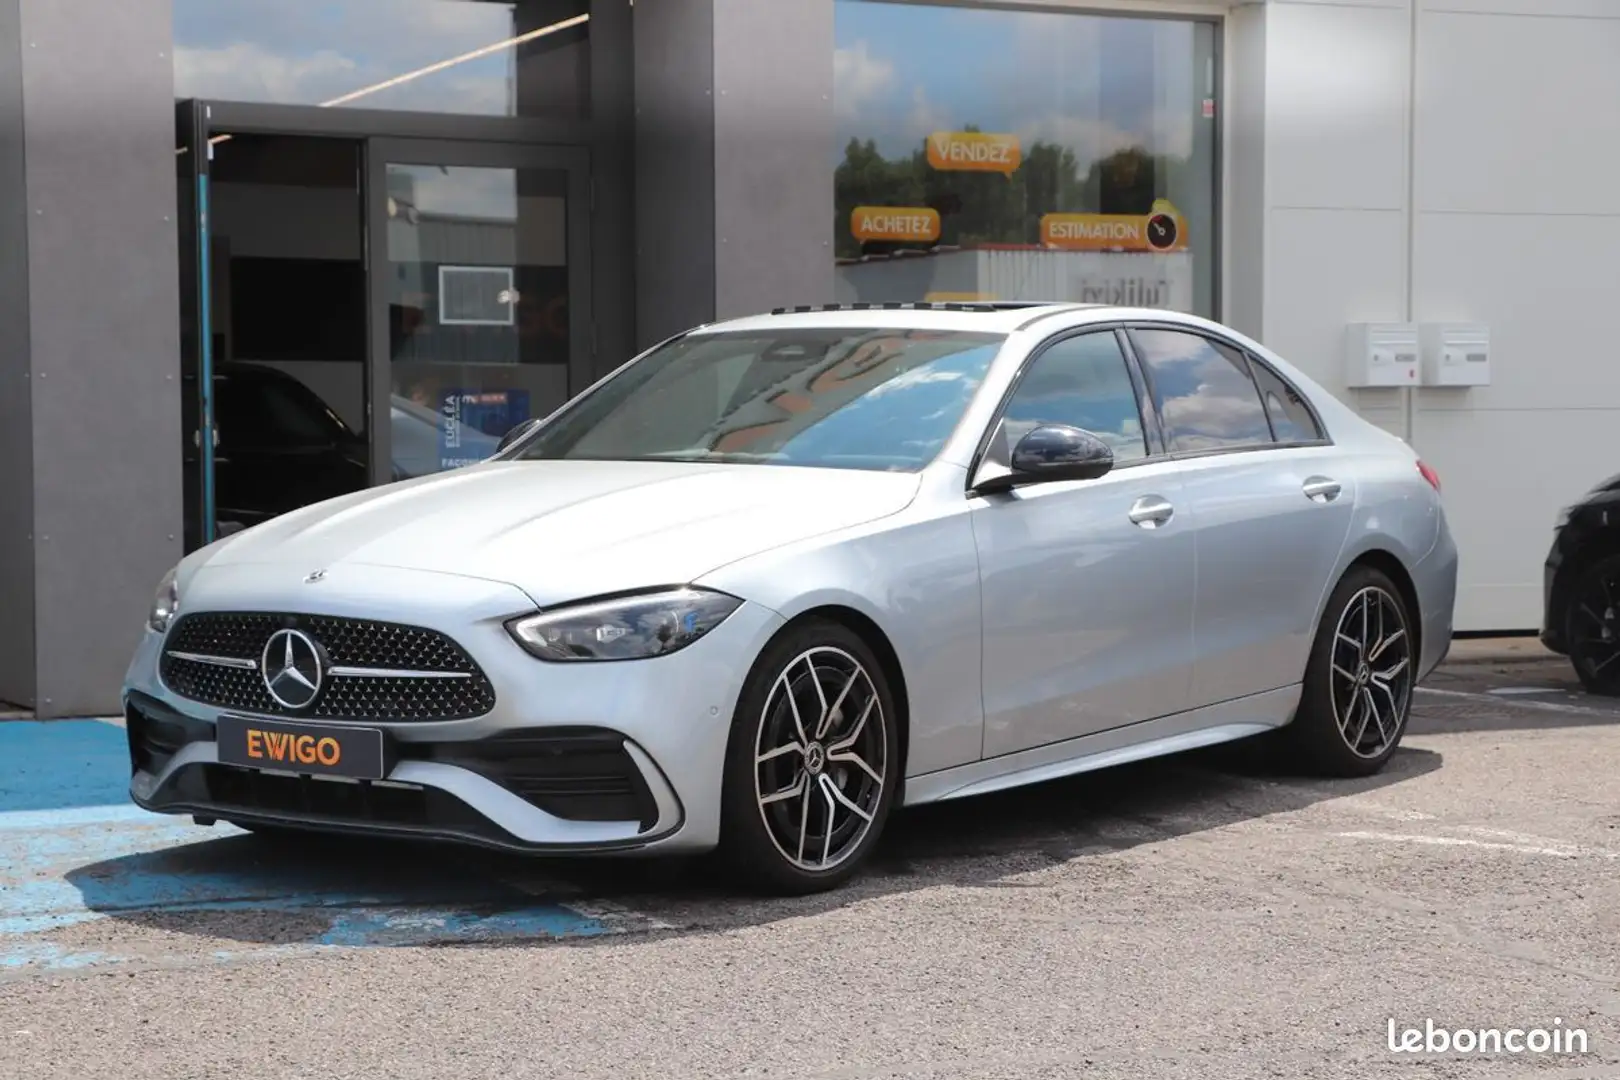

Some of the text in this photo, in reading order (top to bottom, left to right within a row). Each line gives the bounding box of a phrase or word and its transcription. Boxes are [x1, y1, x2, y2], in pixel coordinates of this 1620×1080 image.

[936, 141, 1011, 164] VENDEZ
[860, 216, 931, 235] ACHETEZ
[1048, 221, 1140, 239] ESTIMATION
[246, 728, 341, 767] EWIGO
